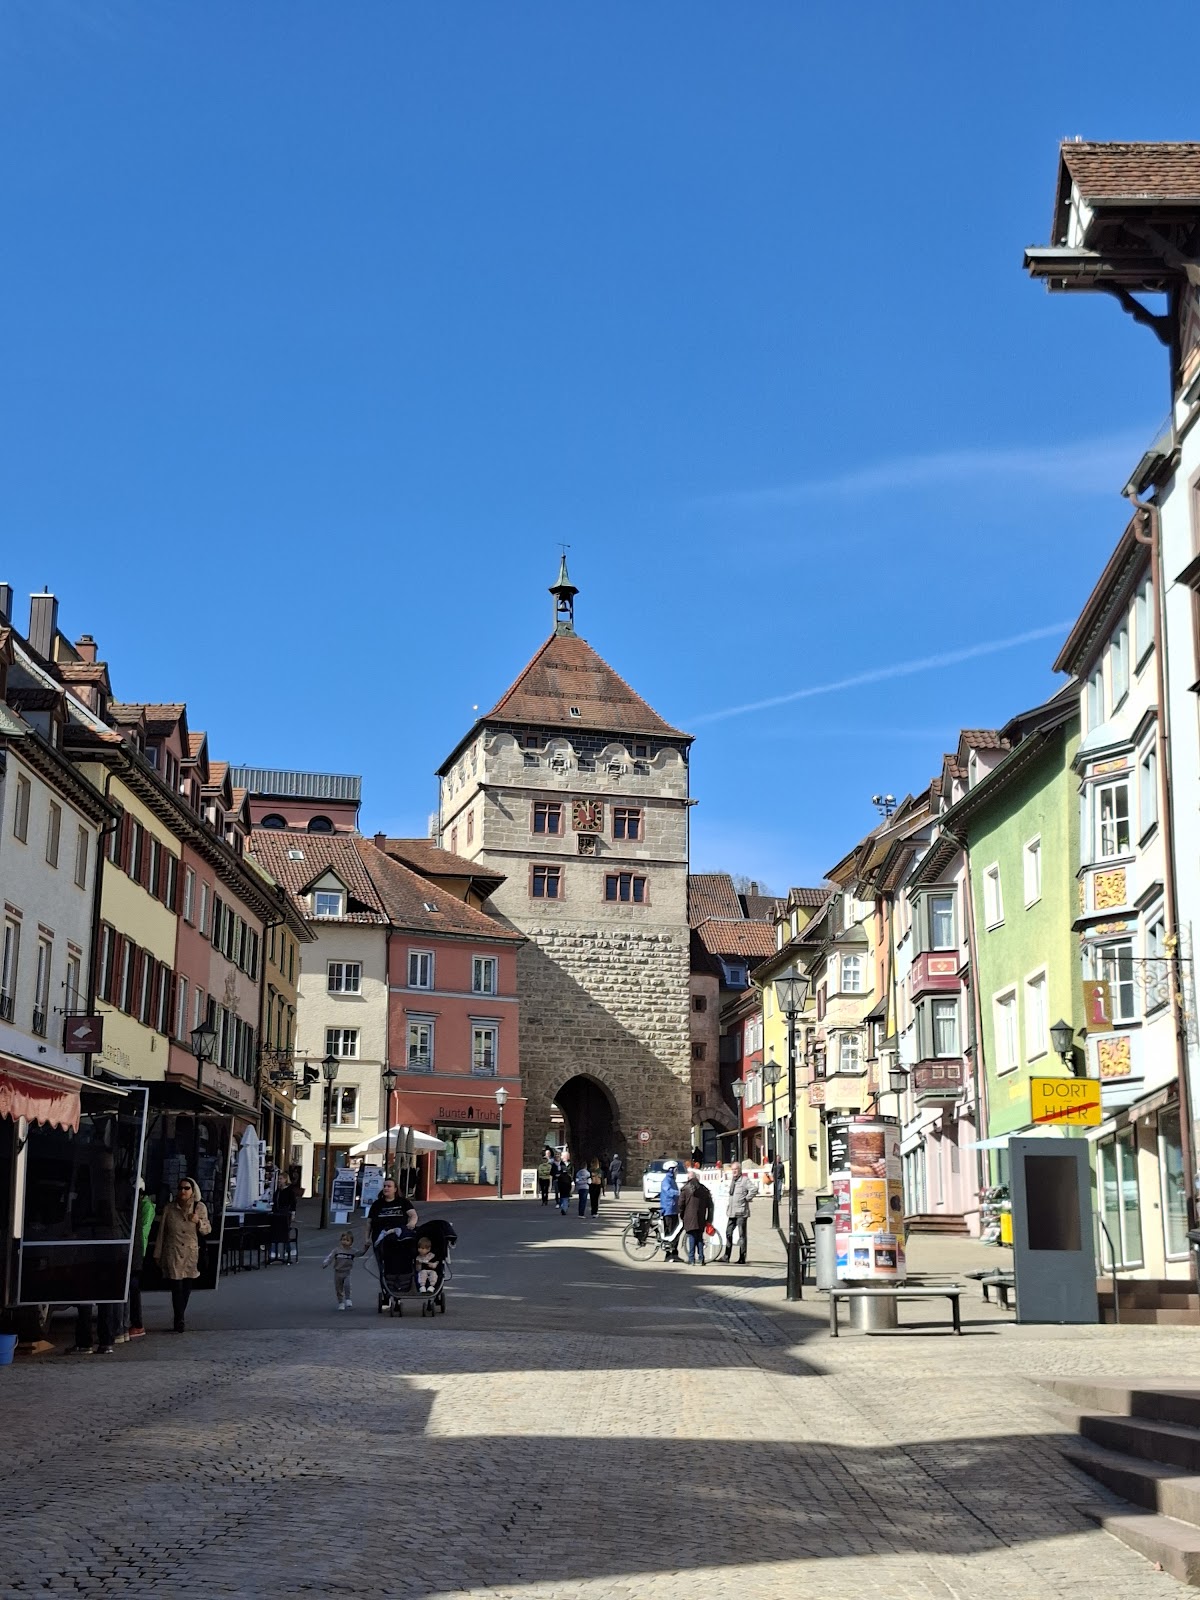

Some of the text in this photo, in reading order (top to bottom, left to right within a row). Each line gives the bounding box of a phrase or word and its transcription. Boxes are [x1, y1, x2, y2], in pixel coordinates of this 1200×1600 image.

[1092, 986, 1109, 1024] i
[1042, 1083, 1088, 1097] DORT
[439, 1106, 501, 1120] Bunte Truhe
[1044, 1104, 1088, 1120] HIER
